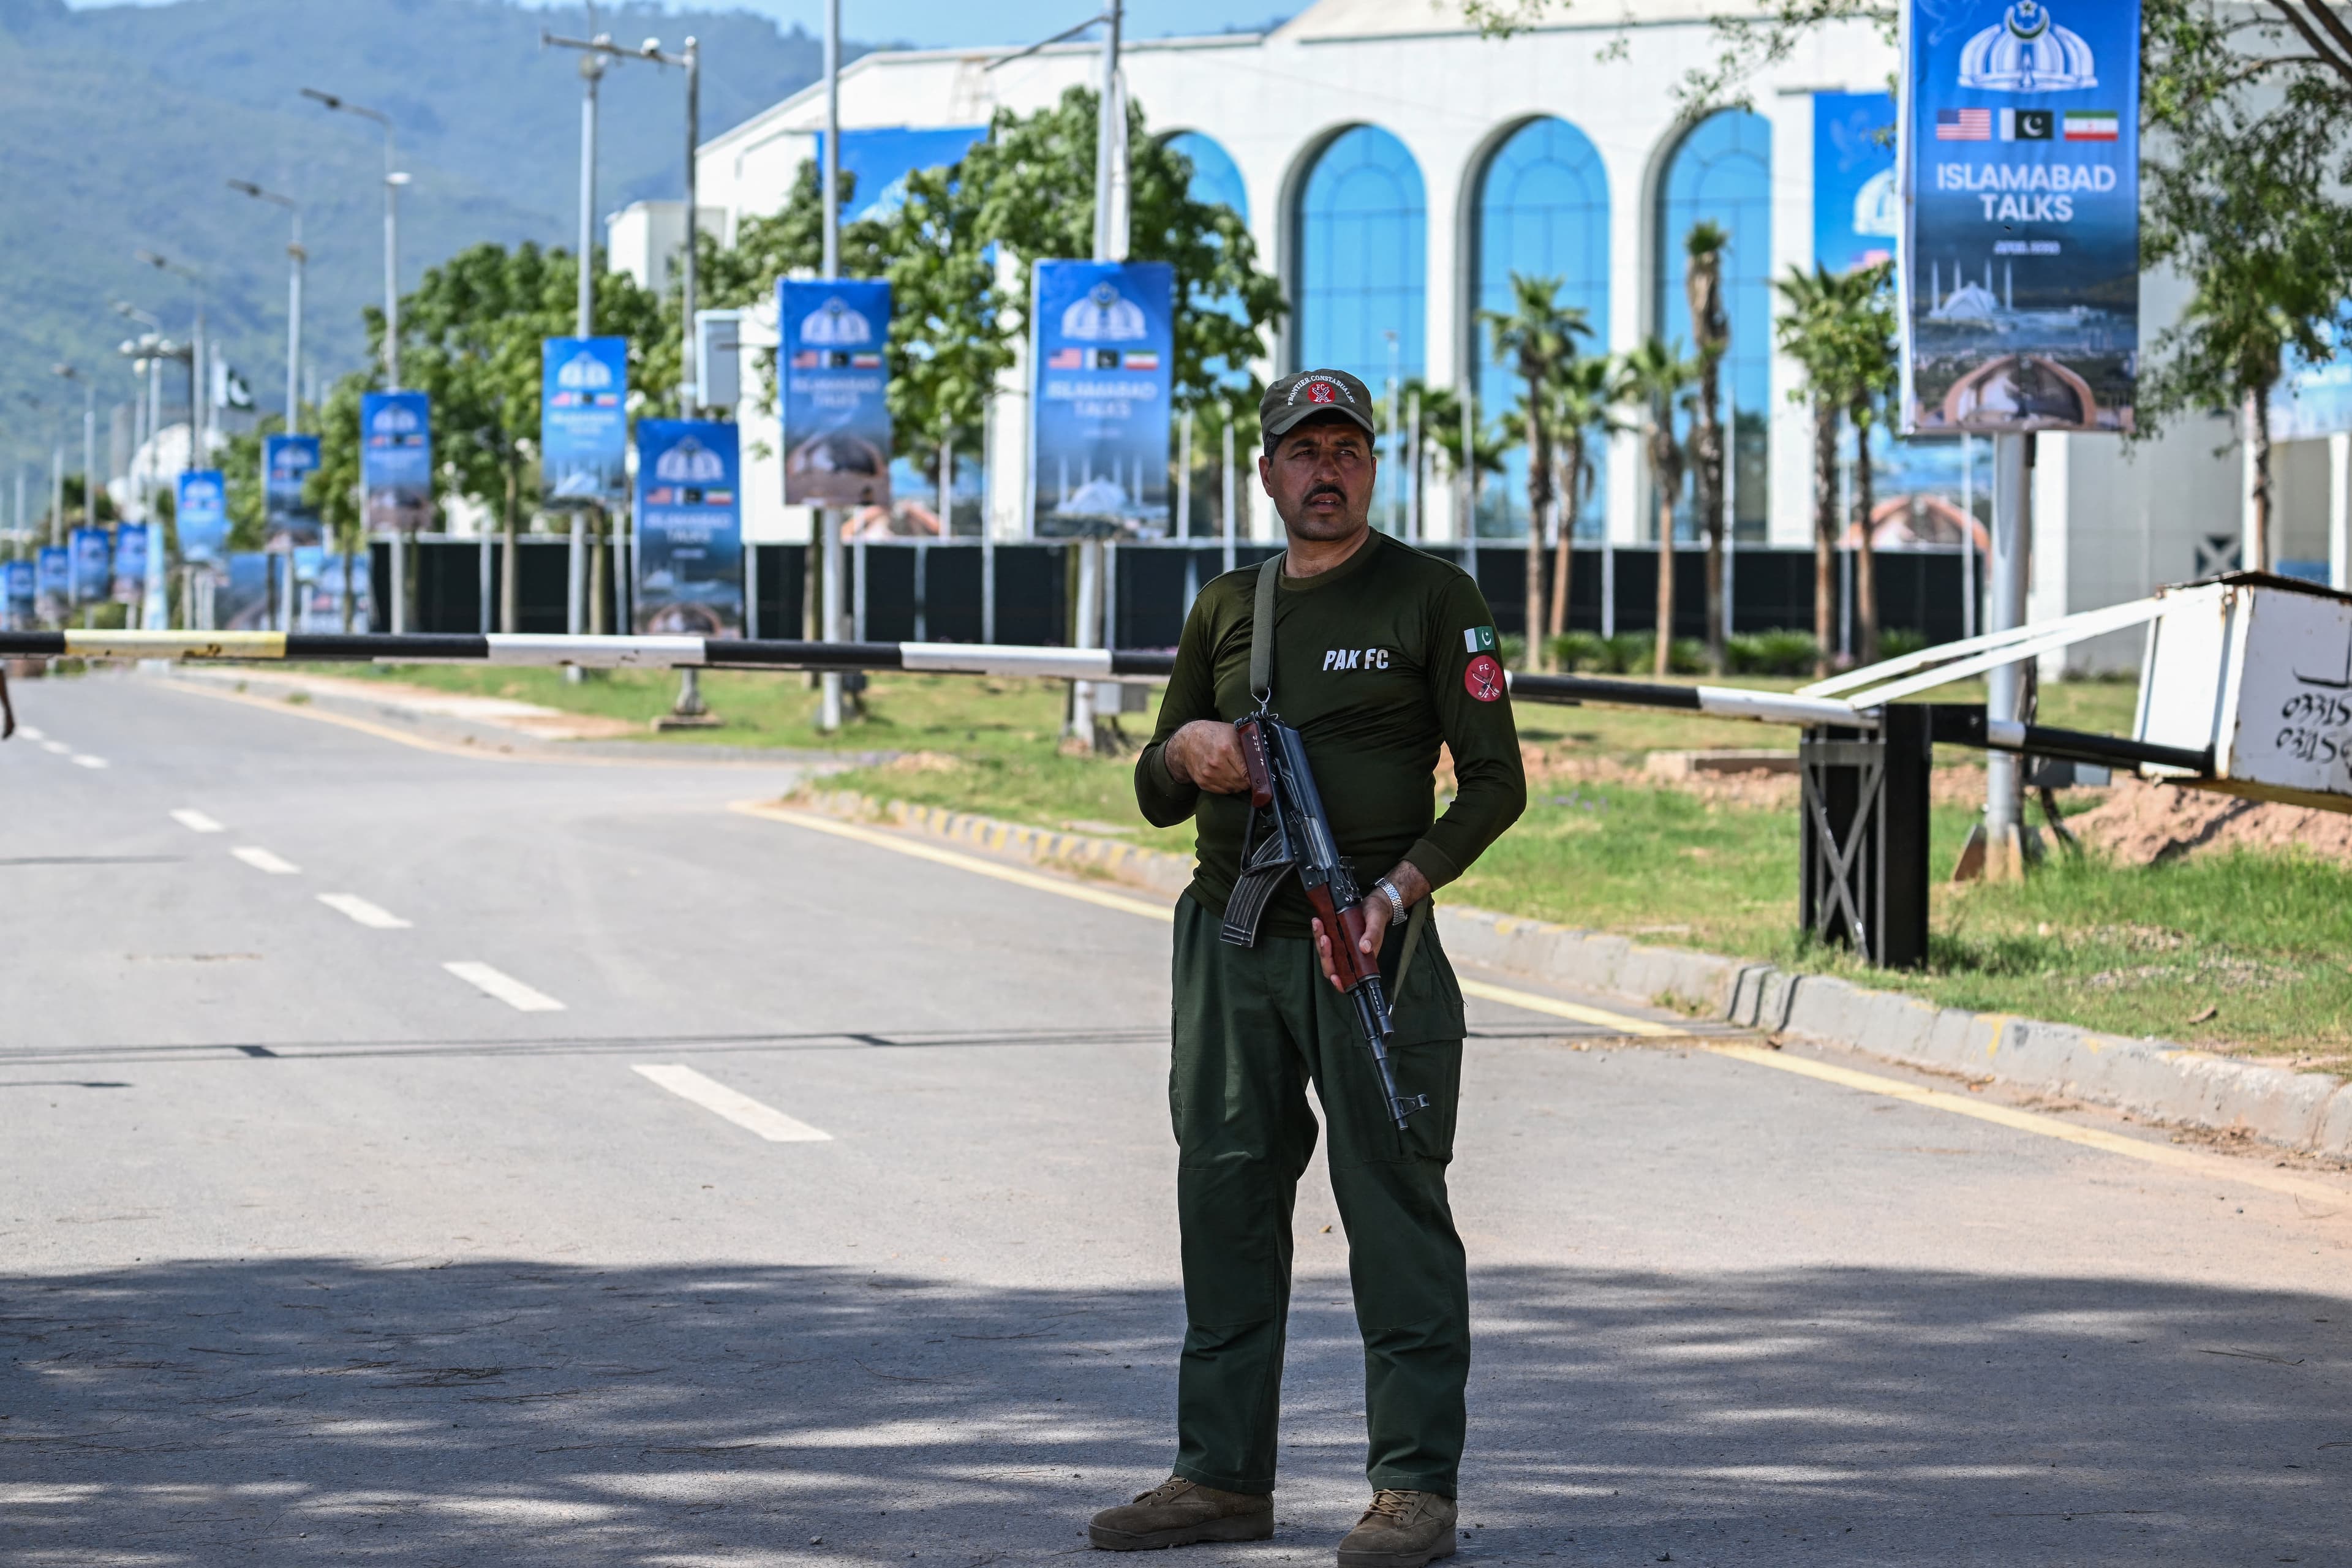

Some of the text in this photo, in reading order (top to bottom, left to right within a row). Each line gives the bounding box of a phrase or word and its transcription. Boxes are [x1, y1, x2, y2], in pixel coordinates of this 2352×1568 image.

[1936, 163, 2117, 192] ISLAMABAD
[1978, 193, 2074, 222] TALKS
[1287, 377, 1311, 406] FRONTIER
[1322, 648, 1389, 671] PAK FC
[1479, 663, 1490, 672] FC
